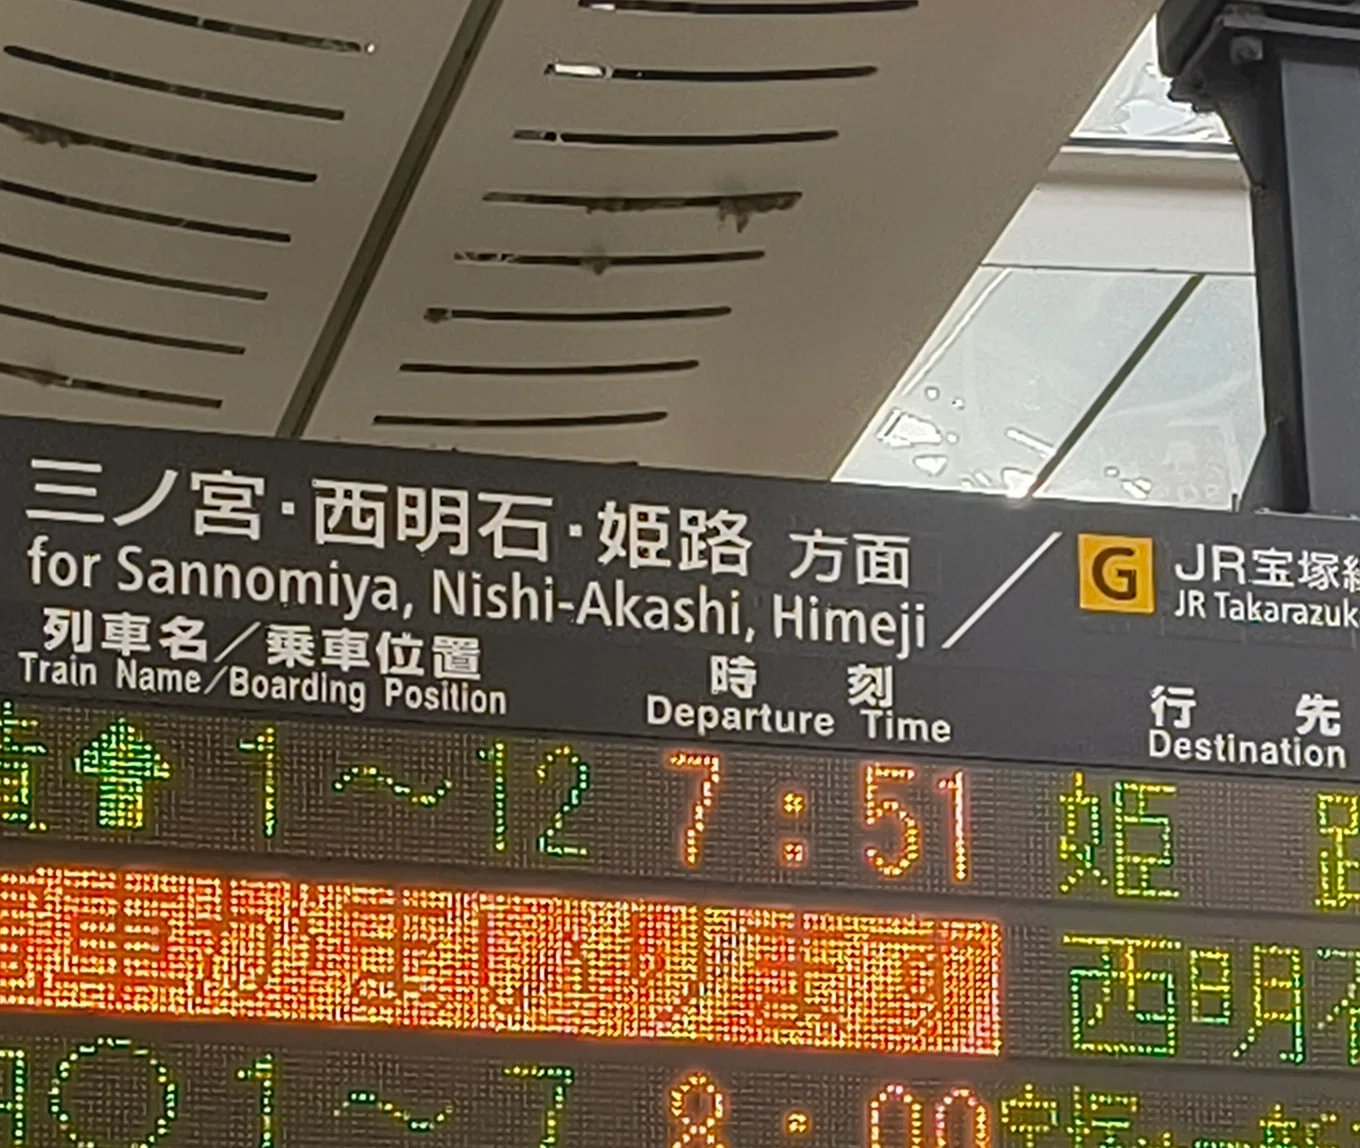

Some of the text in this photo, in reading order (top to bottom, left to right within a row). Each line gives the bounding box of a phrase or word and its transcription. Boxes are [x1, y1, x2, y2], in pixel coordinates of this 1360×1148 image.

[26, 535, 928, 660] for Sannomiya, Nishi-Akashi, Himeji
[1090, 545, 1139, 602] G
[1173, 590, 1206, 619] JR
[18, 650, 98, 688] Train
[384, 677, 508, 716] Position
[646, 694, 951, 744] Departure Time
[1149, 730, 1347, 769] Destination
[664, 749, 969, 882] 7:51
